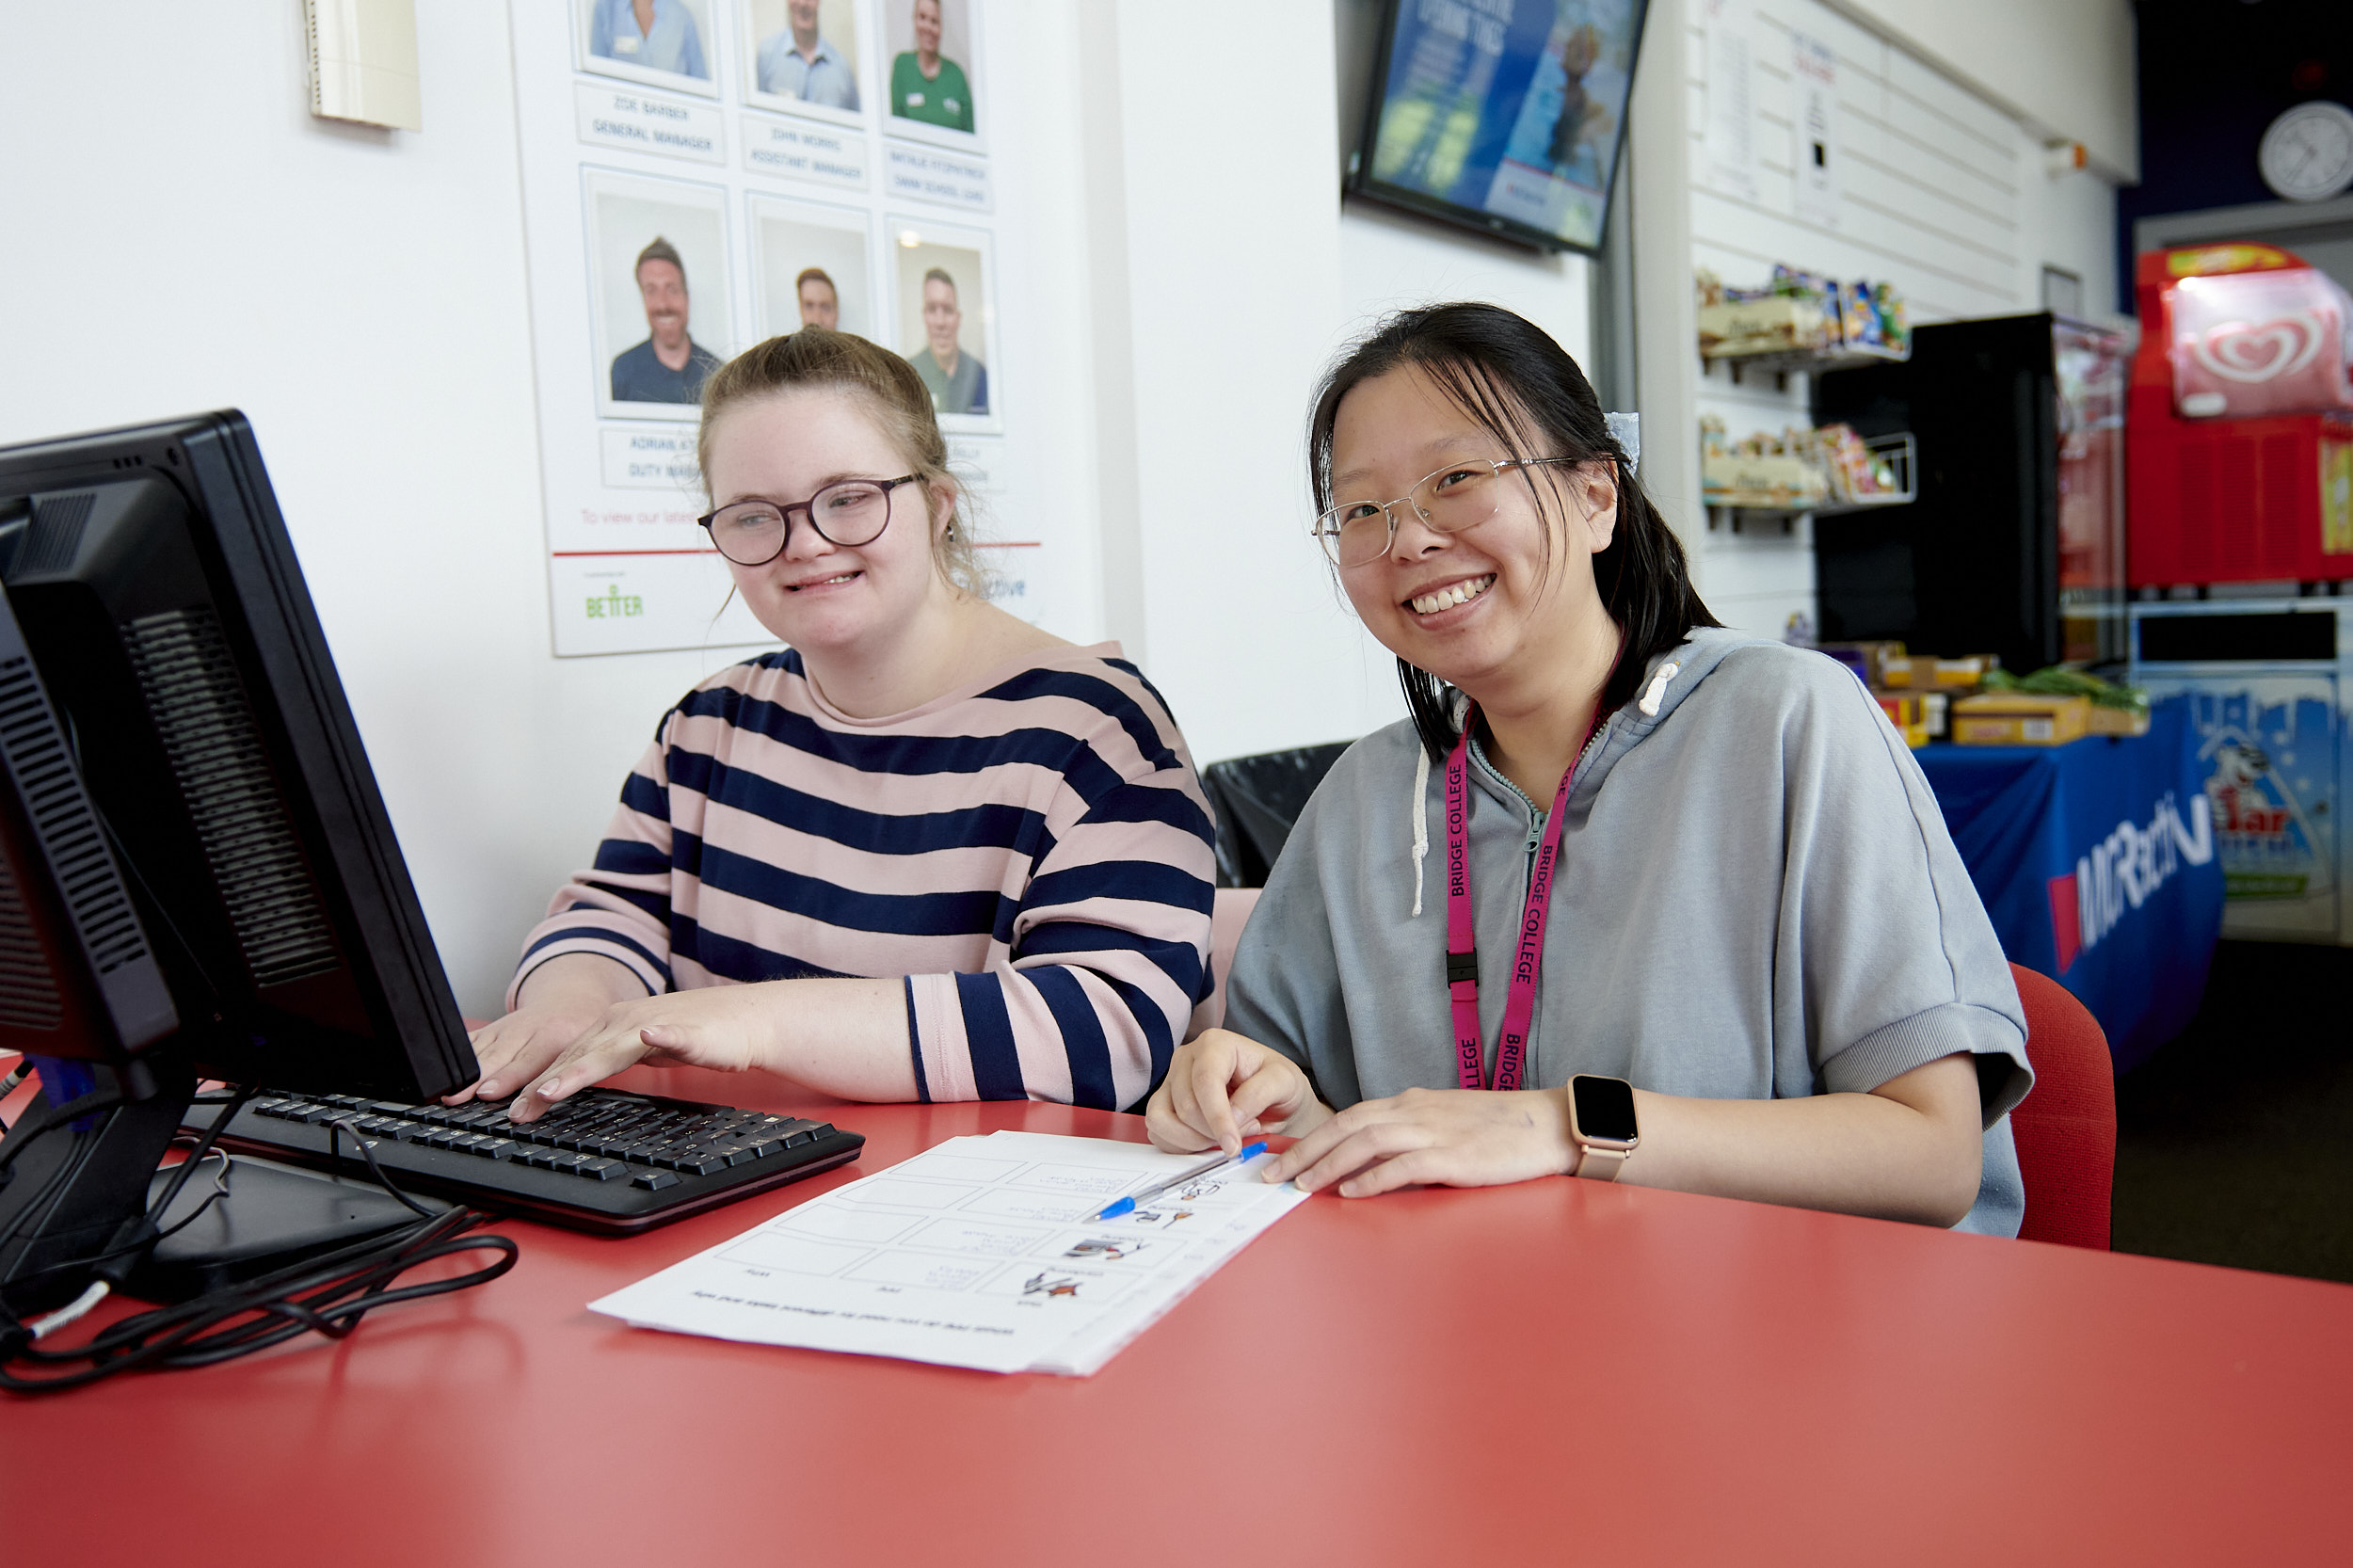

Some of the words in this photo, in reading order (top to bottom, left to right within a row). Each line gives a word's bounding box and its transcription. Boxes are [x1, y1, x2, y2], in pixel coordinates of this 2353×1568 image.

[593, 120, 648, 141] GENERAL
[653, 130, 712, 152] MANAGER
[751, 150, 808, 169] ASSISTANT
[813, 160, 861, 179] MANAGER
[629, 462, 662, 477] DUTY
[582, 509, 599, 524] To
[601, 511, 634, 524] view
[637, 512, 660, 524] our
[585, 595, 643, 618] BETTER
[1449, 764, 1463, 835] COLLEGE
[1451, 840, 1465, 897] BRIDGE
[1531, 845, 1553, 904] BRIDGE
[1515, 908, 1541, 984] COLLEGE
[1462, 1037, 1481, 1090] LLEGE
